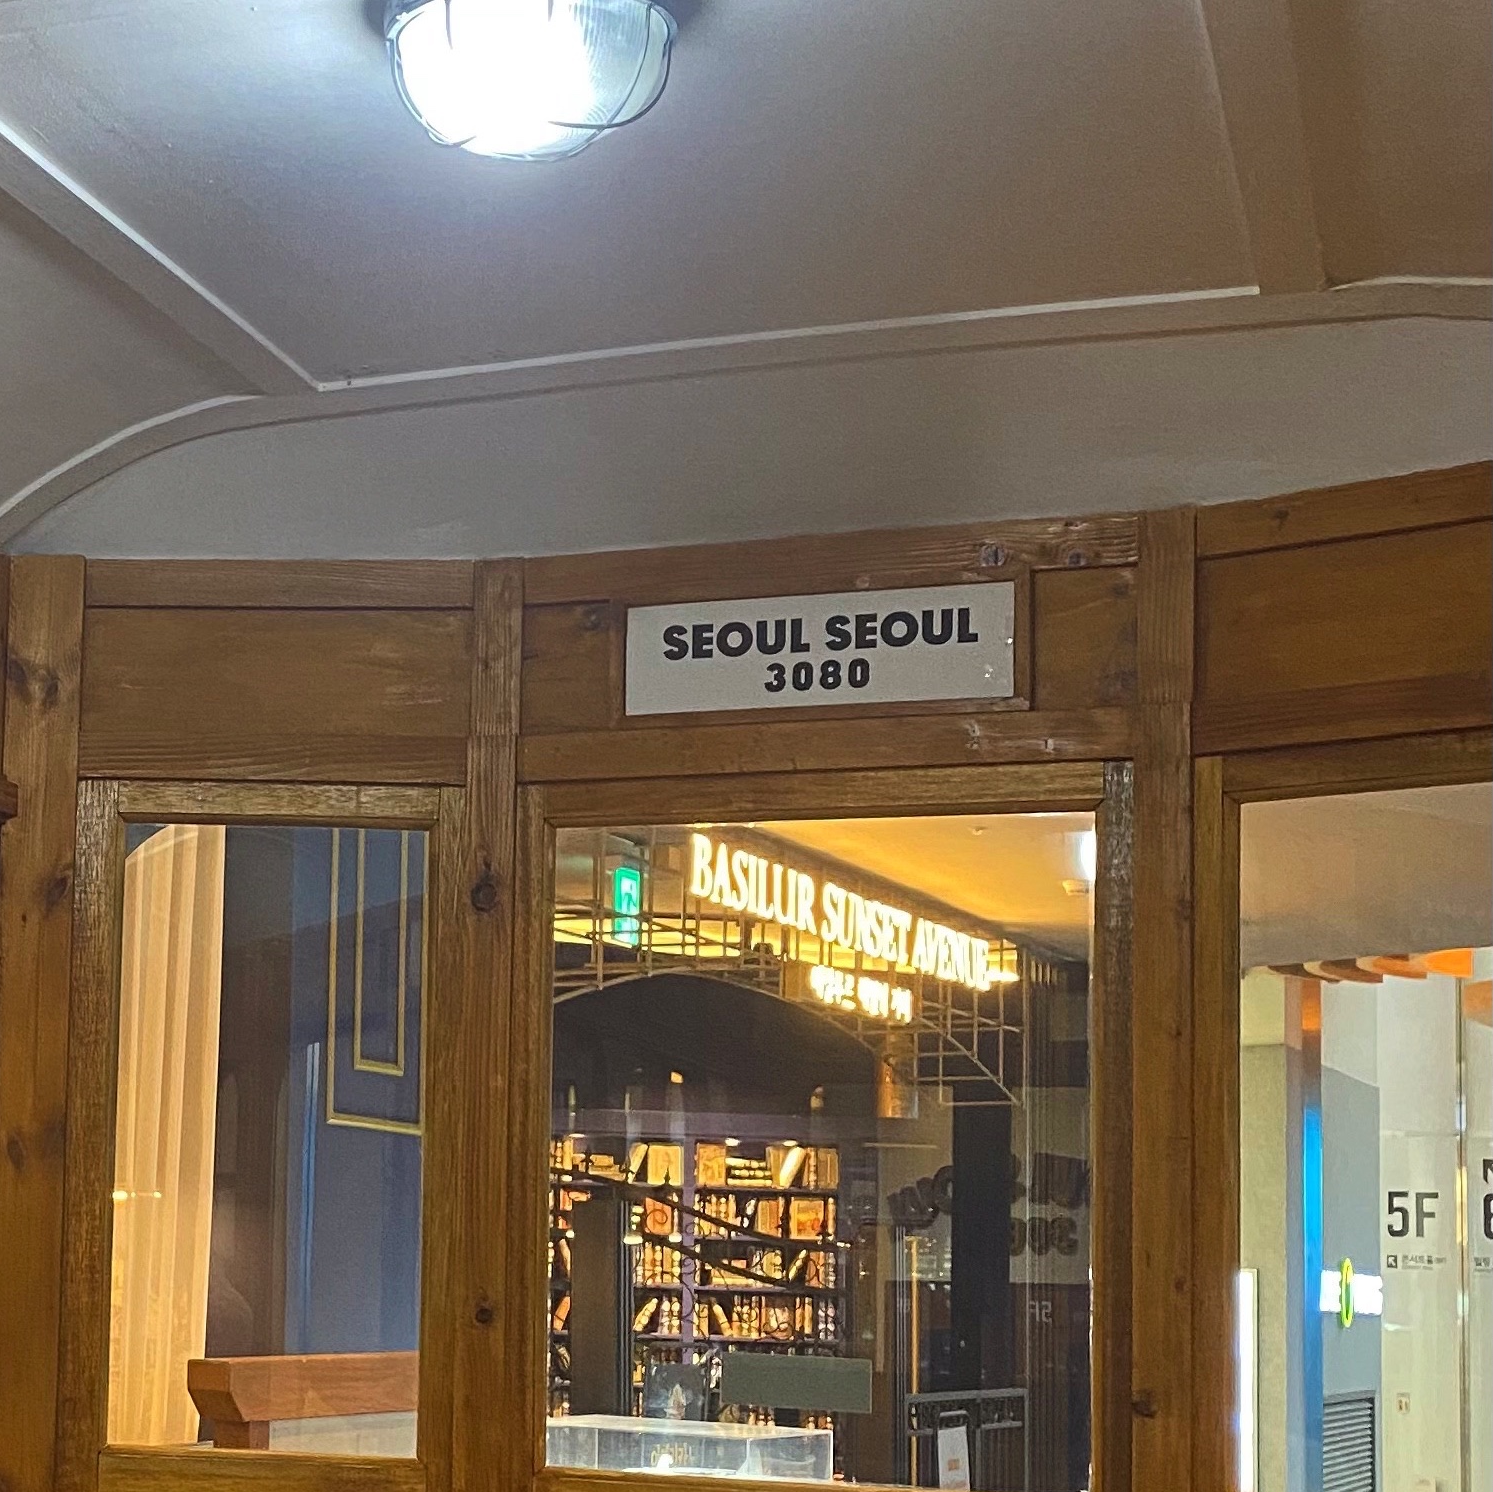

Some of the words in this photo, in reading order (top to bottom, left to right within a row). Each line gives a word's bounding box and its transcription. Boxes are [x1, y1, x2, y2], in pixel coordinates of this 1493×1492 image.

[663, 617, 810, 661] SEOUL
[825, 606, 978, 651] SEOUL
[764, 658, 870, 692] 3080
[690, 833, 818, 935] BASILUR
[821, 881, 911, 966] SUNSET
[911, 917, 990, 991] AVENUE
[1387, 1191, 1439, 1238] 5F
